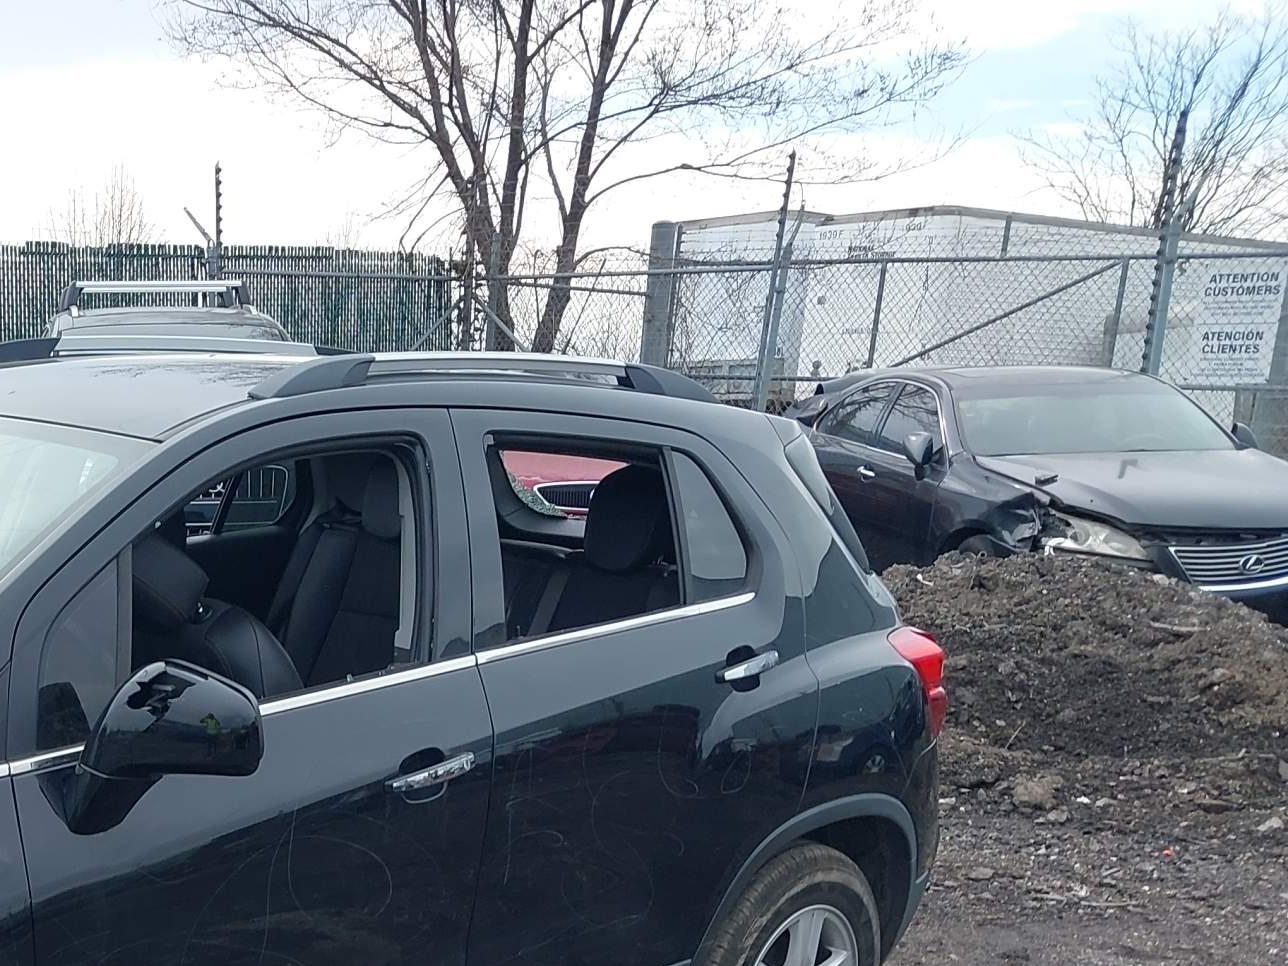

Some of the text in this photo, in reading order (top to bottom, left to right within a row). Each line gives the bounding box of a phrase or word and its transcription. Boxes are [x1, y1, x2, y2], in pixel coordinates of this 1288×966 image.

[1209, 272, 1280, 284] ATTENTION
[1204, 285, 1281, 296] CUSTOMERS
[1201, 330, 1264, 342] ATENCIÓN
[1201, 343, 1260, 354] CLIENTES
